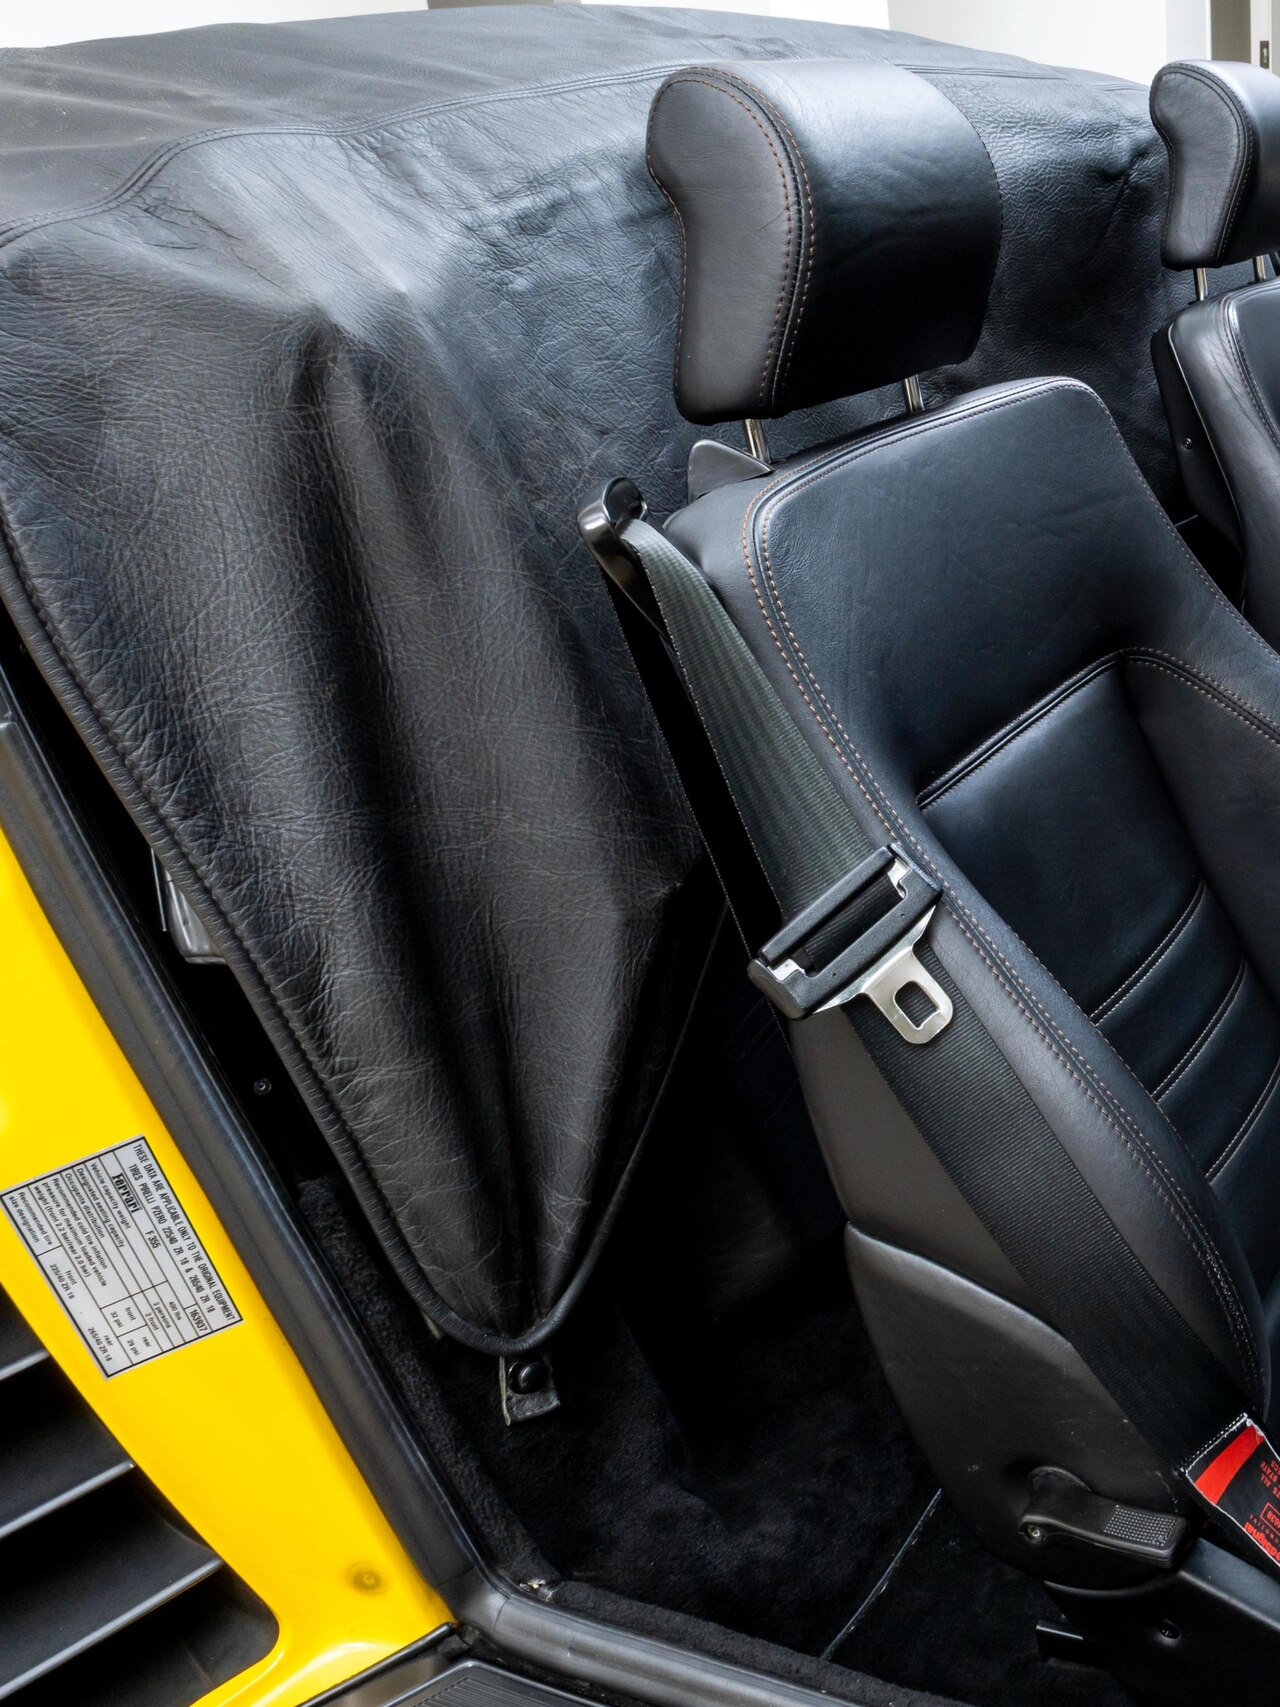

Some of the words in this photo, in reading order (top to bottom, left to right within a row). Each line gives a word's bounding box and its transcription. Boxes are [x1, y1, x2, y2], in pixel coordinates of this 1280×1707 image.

[133, 1143, 149, 1163] THESE
[143, 1163, 157, 1179] DATA
[90, 1162, 105, 1184] Vehicle
[102, 1185, 119, 1209] capacity
[116, 1209, 131, 1229] weight
[111, 1172, 142, 1213] Ferrari
[151, 1179, 165, 1192] ARE
[65, 1172, 86, 1204] Occupants
[83, 1205, 105, 1238] distribution
[76, 1167, 99, 1201] Designated
[92, 1201, 111, 1225] seating
[108, 1223, 124, 1248] capacity
[158, 1192, 183, 1226] APPLICABLE
[9, 1196, 19, 1208] size
[16, 1208, 39, 1242] designation
[18, 1191, 47, 1235] Recommended
[43, 1234, 52, 1245] tire
[52, 1177, 81, 1221] Recommended
[77, 1221, 88, 1235] cold
[85, 1234, 93, 1245] tire
[91, 1245, 107, 1269] inflation
[34, 1185, 49, 1205] weight
[44, 1205, 59, 1222] (front
[55, 1222, 65, 1232] 2.2
[61, 1232, 77, 1254] bar/rear
[74, 1255, 84, 1265] 2.0
[80, 1264, 91, 1277] bar)
[41, 1182, 61, 1207] pressure
[58, 1207, 66, 1217] for
[63, 1217, 83, 1245] maximum
[81, 1245, 96, 1266] loaded
[92, 1266, 106, 1286] vehicle
[128, 1163, 143, 1181] TIRES
[138, 1182, 156, 1204] PIRELLI
[151, 1205, 167, 1224] PZERO
[173, 1246, 184, 1255] ZR
[180, 1257, 189, 1265] 18
[199, 1294, 210, 1303] ZR
[206, 1305, 215, 1313] 18
[177, 1226, 191, 1241] ONLY
[186, 1241, 197, 1250] TO
[191, 1250, 203, 1263] THE
[65, 1270, 77, 1285] front
[197, 1263, 216, 1289] ORIGINAL
[125, 1306, 136, 1321] front
[169, 1301, 177, 1311] 400
[212, 1289, 235, 1320] EQUIPMENT
[113, 1318, 122, 1328] psi
[148, 1316, 159, 1330] front
[154, 1306, 171, 1328] persons
[189, 1309, 208, 1331] 163937
[103, 1335, 113, 1345] rear
[142, 1336, 151, 1347] rear
[130, 1347, 140, 1355] psi
[1262, 1475, 1271, 1486] ALL
